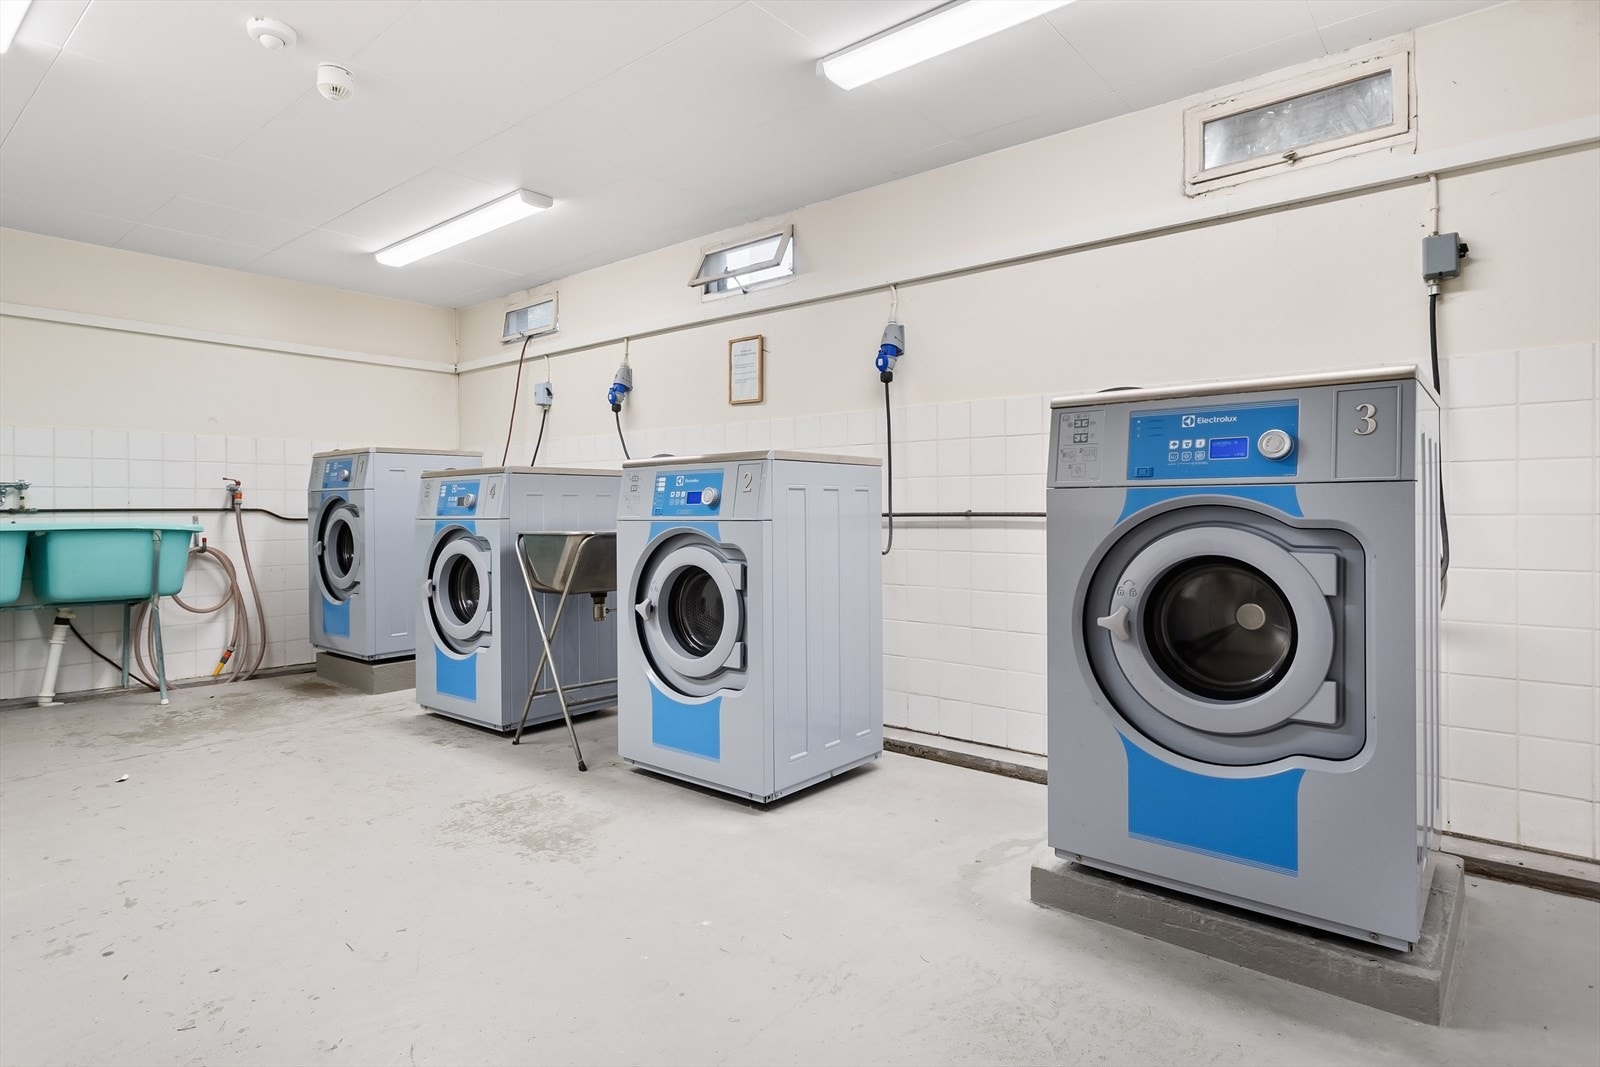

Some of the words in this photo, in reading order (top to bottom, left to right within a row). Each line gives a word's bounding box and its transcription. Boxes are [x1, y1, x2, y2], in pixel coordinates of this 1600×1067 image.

[1197, 416, 1238, 424] Electrolux
[1354, 403, 1377, 436] 3
[489, 483, 497, 499] 4
[742, 471, 753, 494] 2
